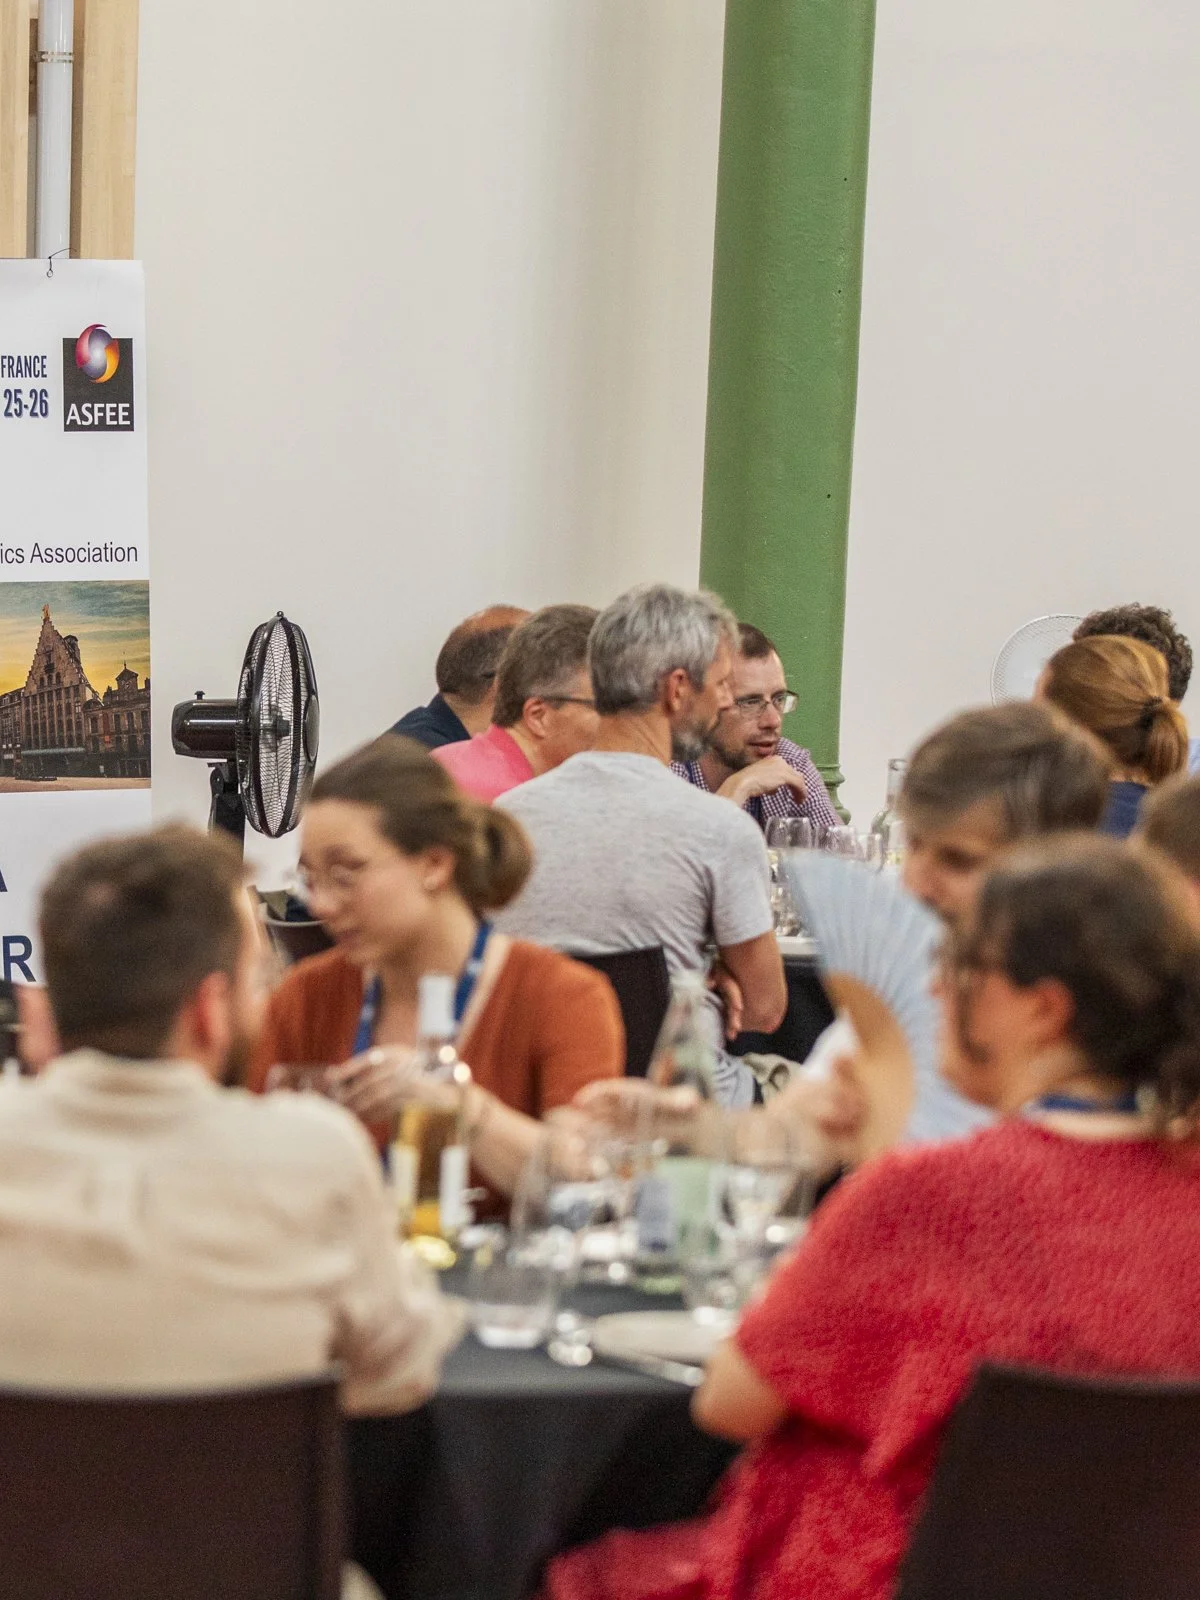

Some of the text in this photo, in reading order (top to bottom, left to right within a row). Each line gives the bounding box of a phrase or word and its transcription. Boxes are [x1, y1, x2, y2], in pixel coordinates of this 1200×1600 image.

[0, 355, 48, 379] FRANCE
[3, 388, 49, 418] 25-26
[66, 403, 131, 426] ASFEE
[29, 541, 138, 564] Association
